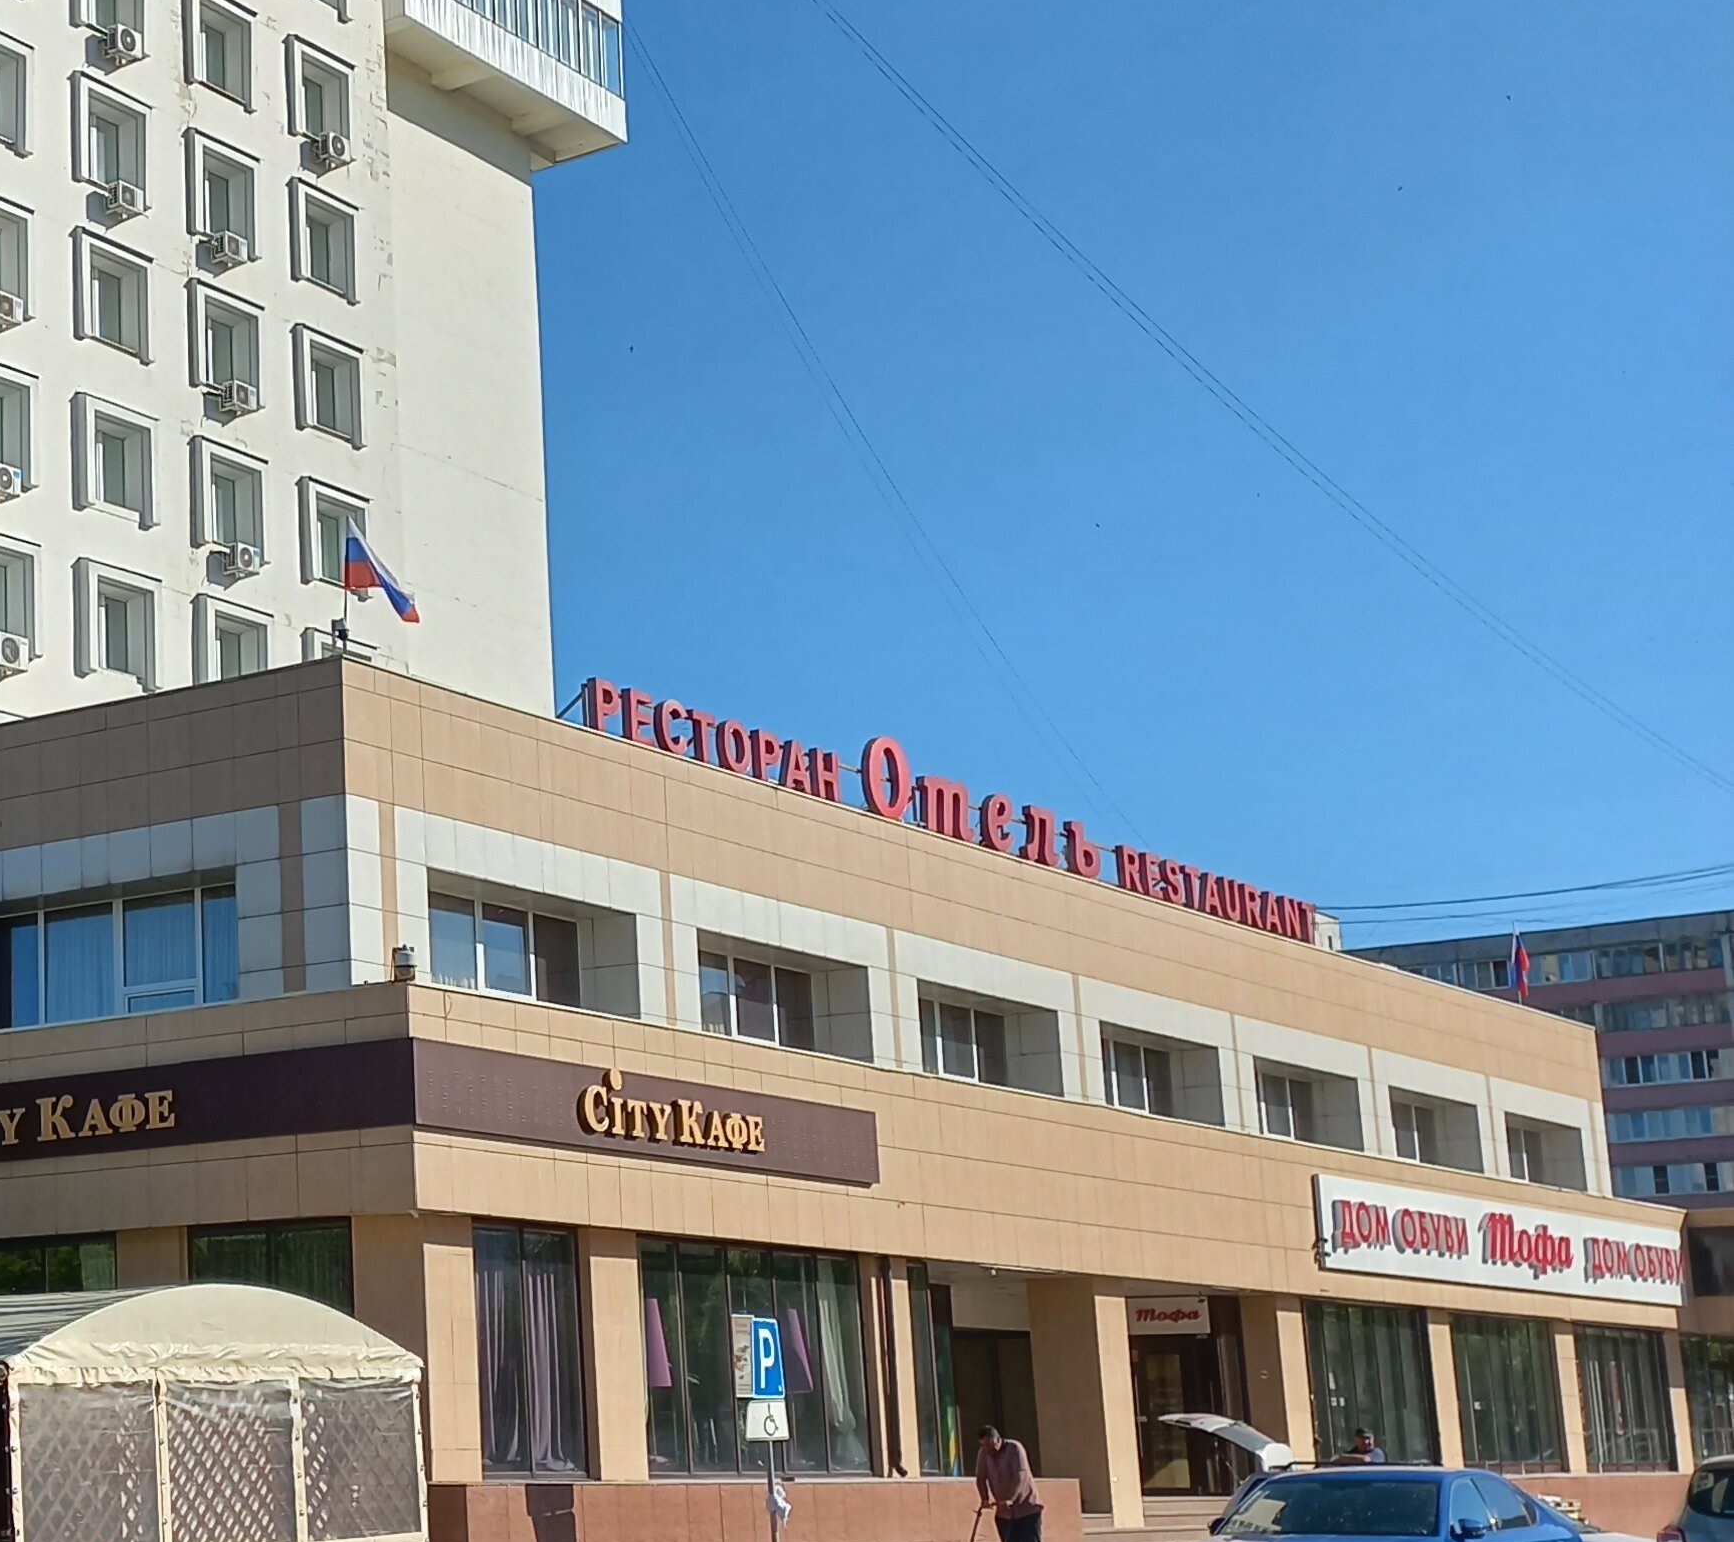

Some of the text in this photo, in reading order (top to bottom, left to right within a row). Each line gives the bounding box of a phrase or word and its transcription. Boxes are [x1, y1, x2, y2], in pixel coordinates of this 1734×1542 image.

[584, 676, 1316, 944] РЕСТОРАН Отель RESTAURANT
[1332, 1200, 1392, 1254] ДОМ
[1392, 1208, 1470, 1260] ОБУВИ
[1583, 1236, 1630, 1284] ДОМ
[1628, 1242, 1687, 1286] ОБУВИ
[759, 1328, 775, 1389] P
